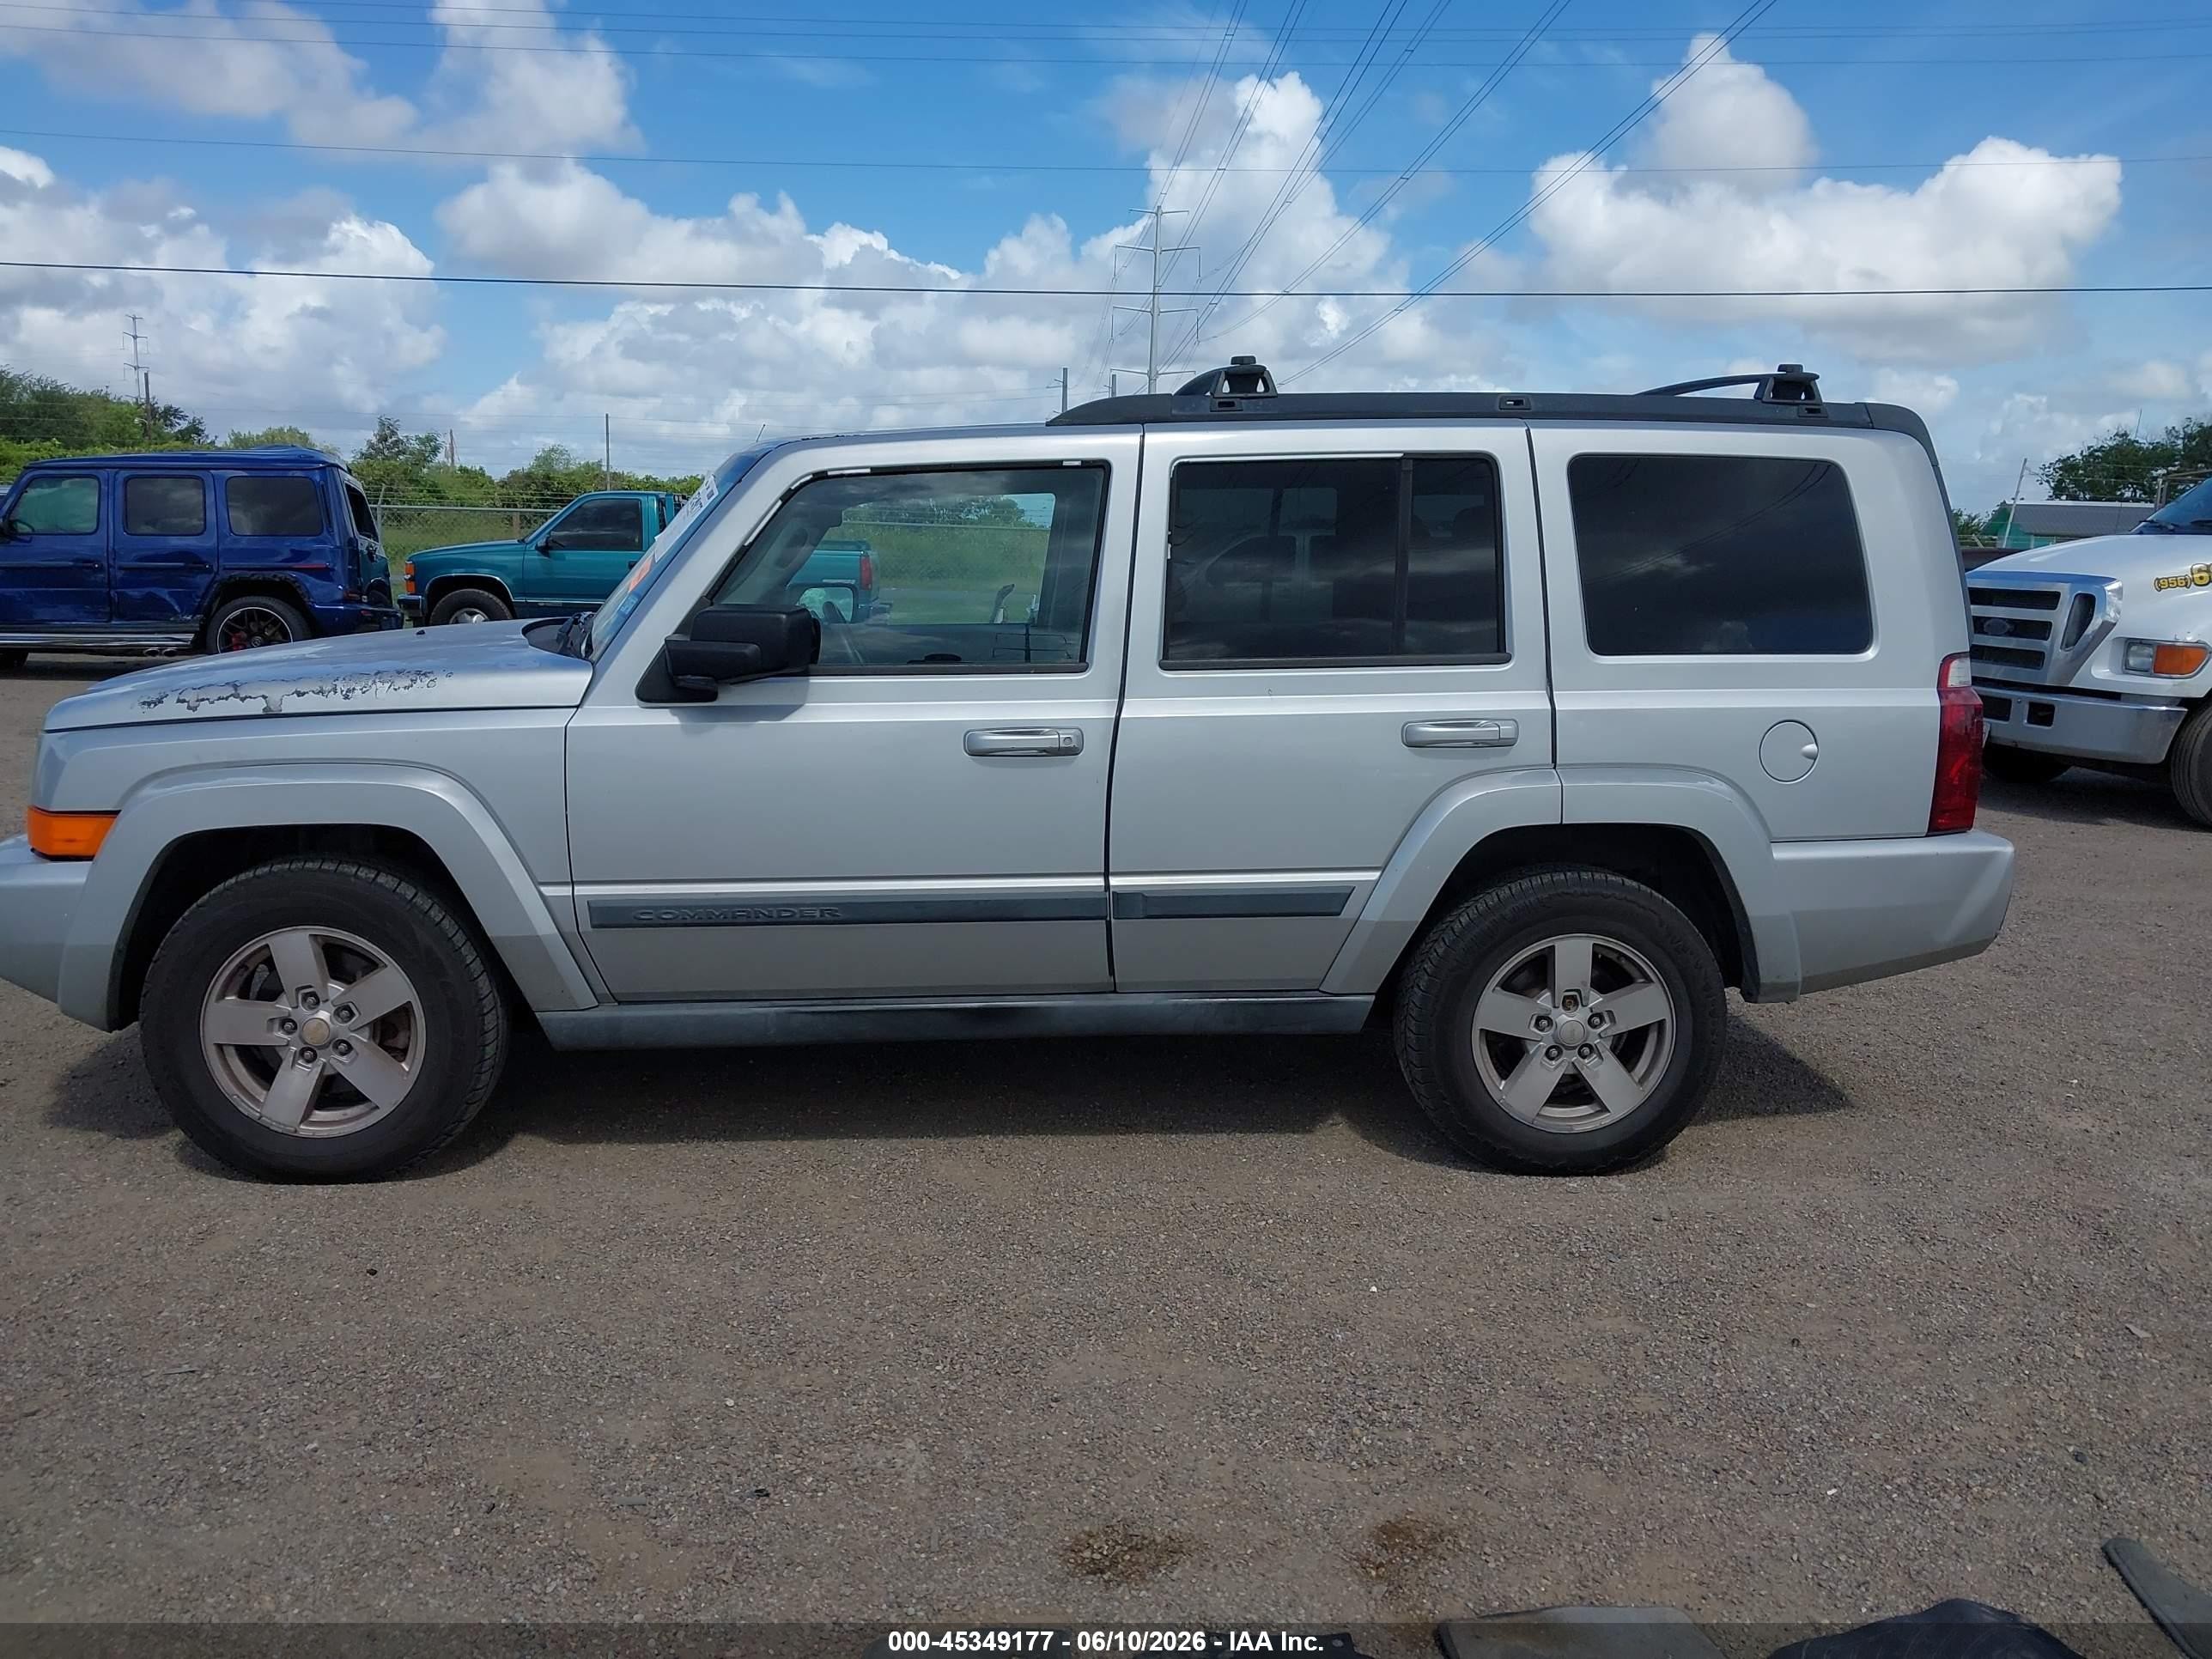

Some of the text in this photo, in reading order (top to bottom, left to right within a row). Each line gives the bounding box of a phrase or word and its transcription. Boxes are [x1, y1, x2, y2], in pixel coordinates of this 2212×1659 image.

[2154, 563, 2212, 592] (956) 6
[633, 907, 842, 921] COMMANDER
